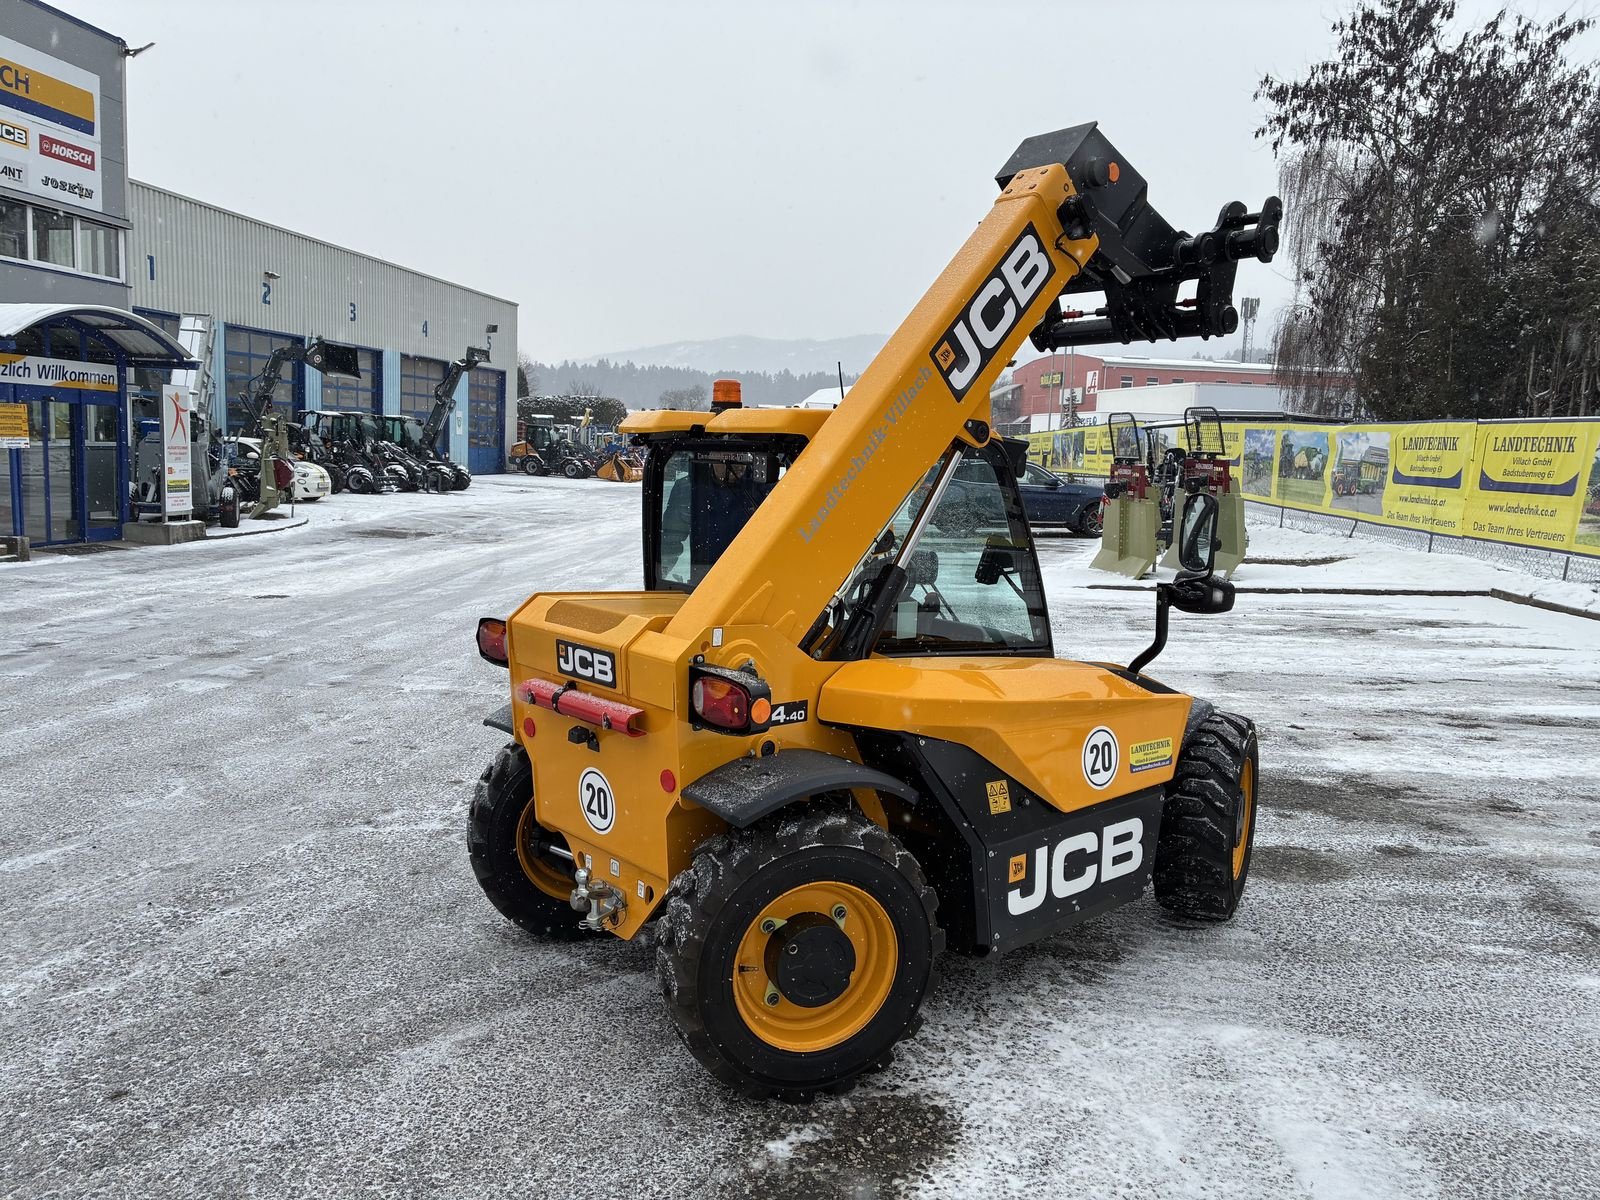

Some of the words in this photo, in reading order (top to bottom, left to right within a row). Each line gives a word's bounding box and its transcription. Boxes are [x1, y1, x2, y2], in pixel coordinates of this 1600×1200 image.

[0, 123, 27, 145] CB
[51, 143, 92, 165] HORSCH
[147, 255, 155, 280] 1
[262, 282, 271, 305] 2
[350, 302, 356, 322] 3
[948, 234, 1050, 390] JCB
[422, 320, 428, 337] 4
[37, 363, 115, 386] Willkommen
[799, 364, 933, 544] Landtechnik-Villach
[1402, 437, 1460, 451] LANDTECHNIK
[1493, 436, 1577, 453] LANDTECHNIK
[1512, 457, 1531, 466] Villach
[1532, 458, 1552, 466] GmbH
[1488, 502, 1557, 517] www.landtechnik.co.at
[1422, 515, 1456, 528] Vertrauens
[1473, 521, 1486, 532] Das
[1488, 523, 1504, 535] Team
[1506, 525, 1524, 537] Ihres
[1525, 527, 1565, 542] Vertrauens
[560, 646, 613, 682] JCB
[771, 706, 805, 723] 4.40
[1089, 741, 1112, 775] 20
[1130, 740, 1171, 754] LANDTECHNIK
[586, 782, 608, 821] 20
[1007, 817, 1143, 916] JCB
